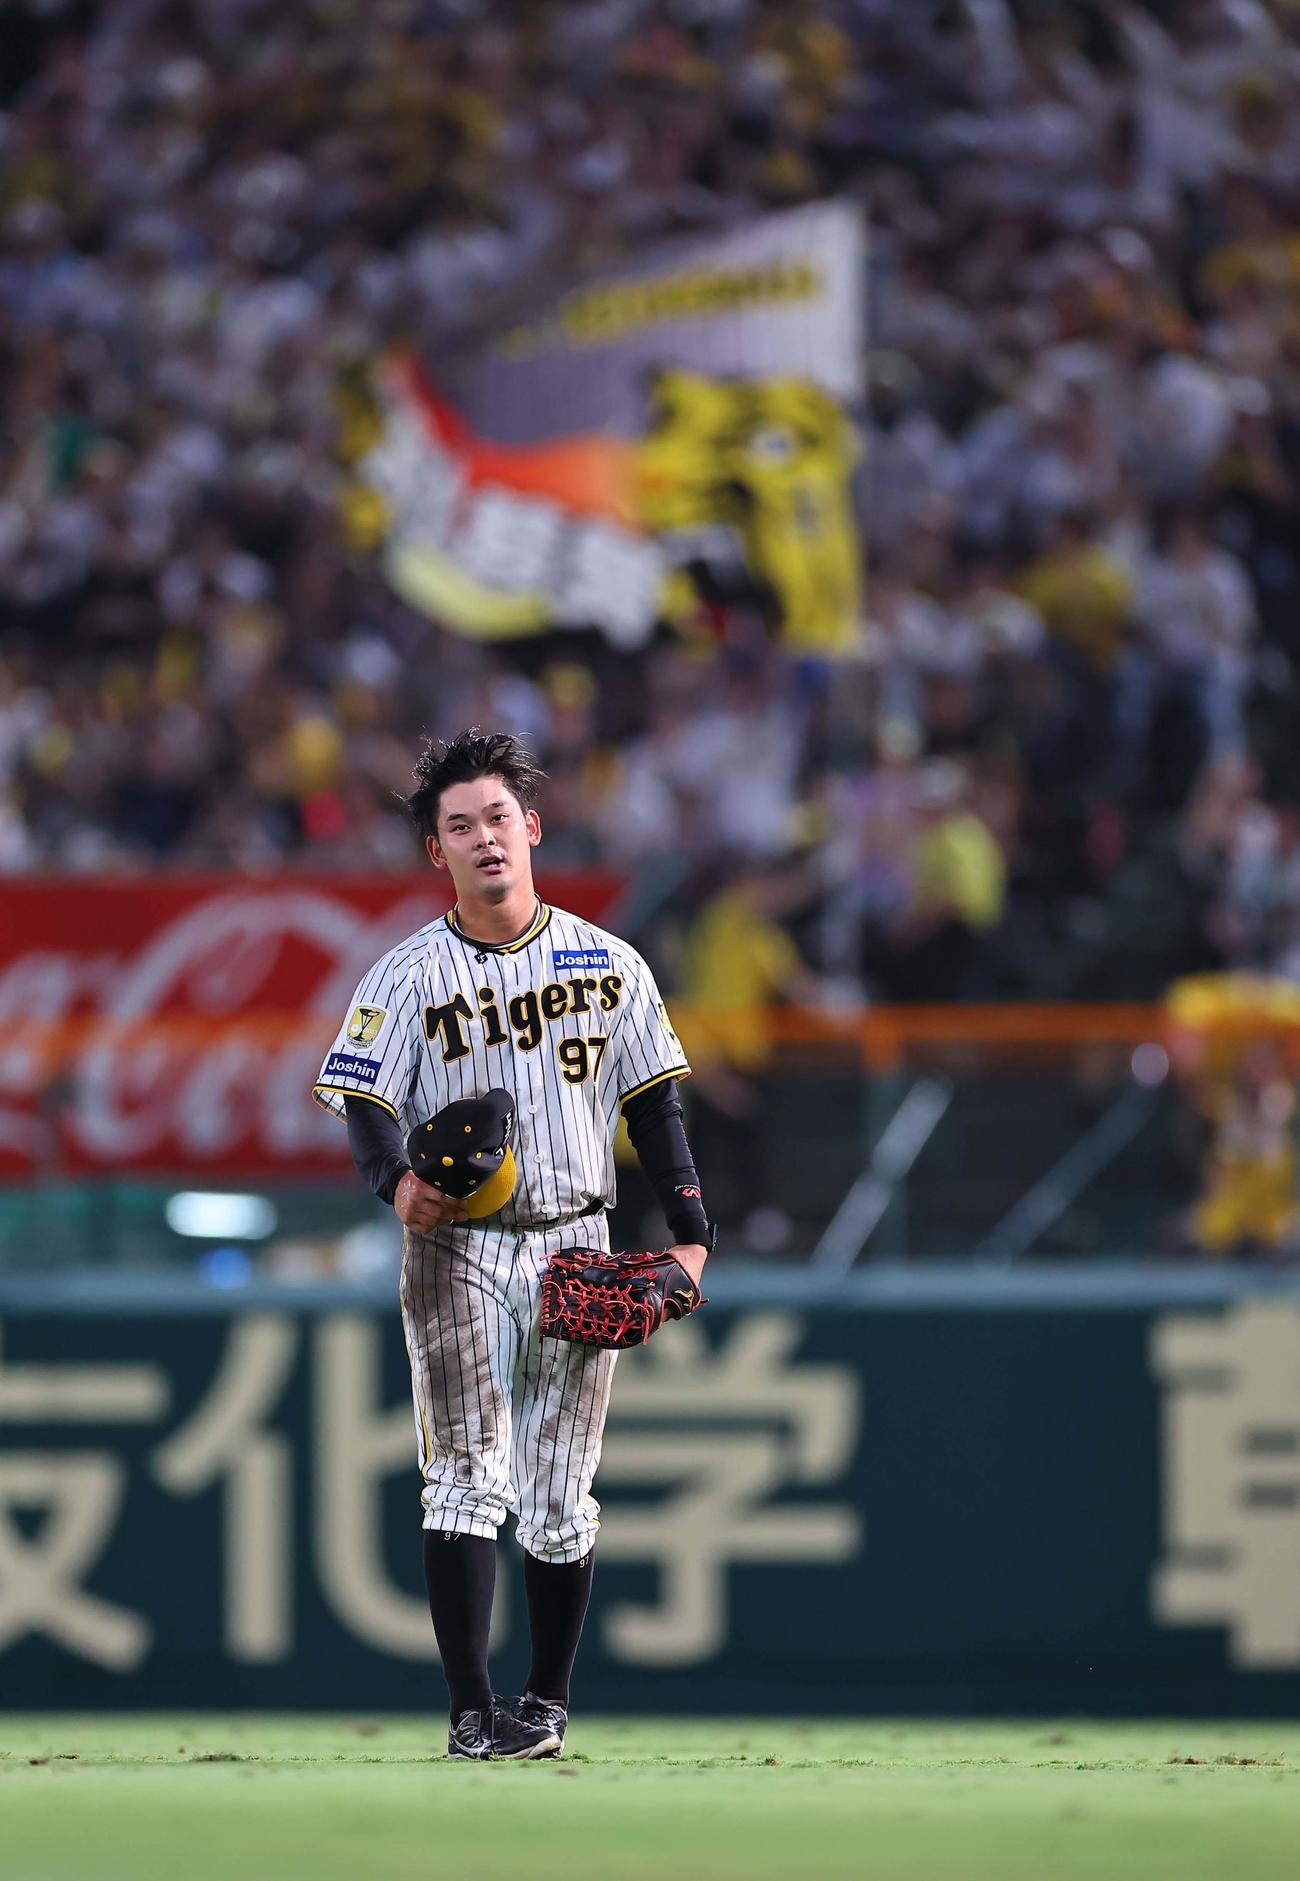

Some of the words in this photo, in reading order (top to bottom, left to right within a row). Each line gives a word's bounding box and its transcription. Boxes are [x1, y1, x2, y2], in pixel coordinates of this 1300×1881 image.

[555, 953, 609, 967] Joshin
[424, 975, 622, 1063] Tigers
[328, 1057, 376, 1079] Joshin
[557, 1036, 607, 1085] 97
[443, 1531, 461, 1542] 97
[579, 1556, 590, 1569] 97
